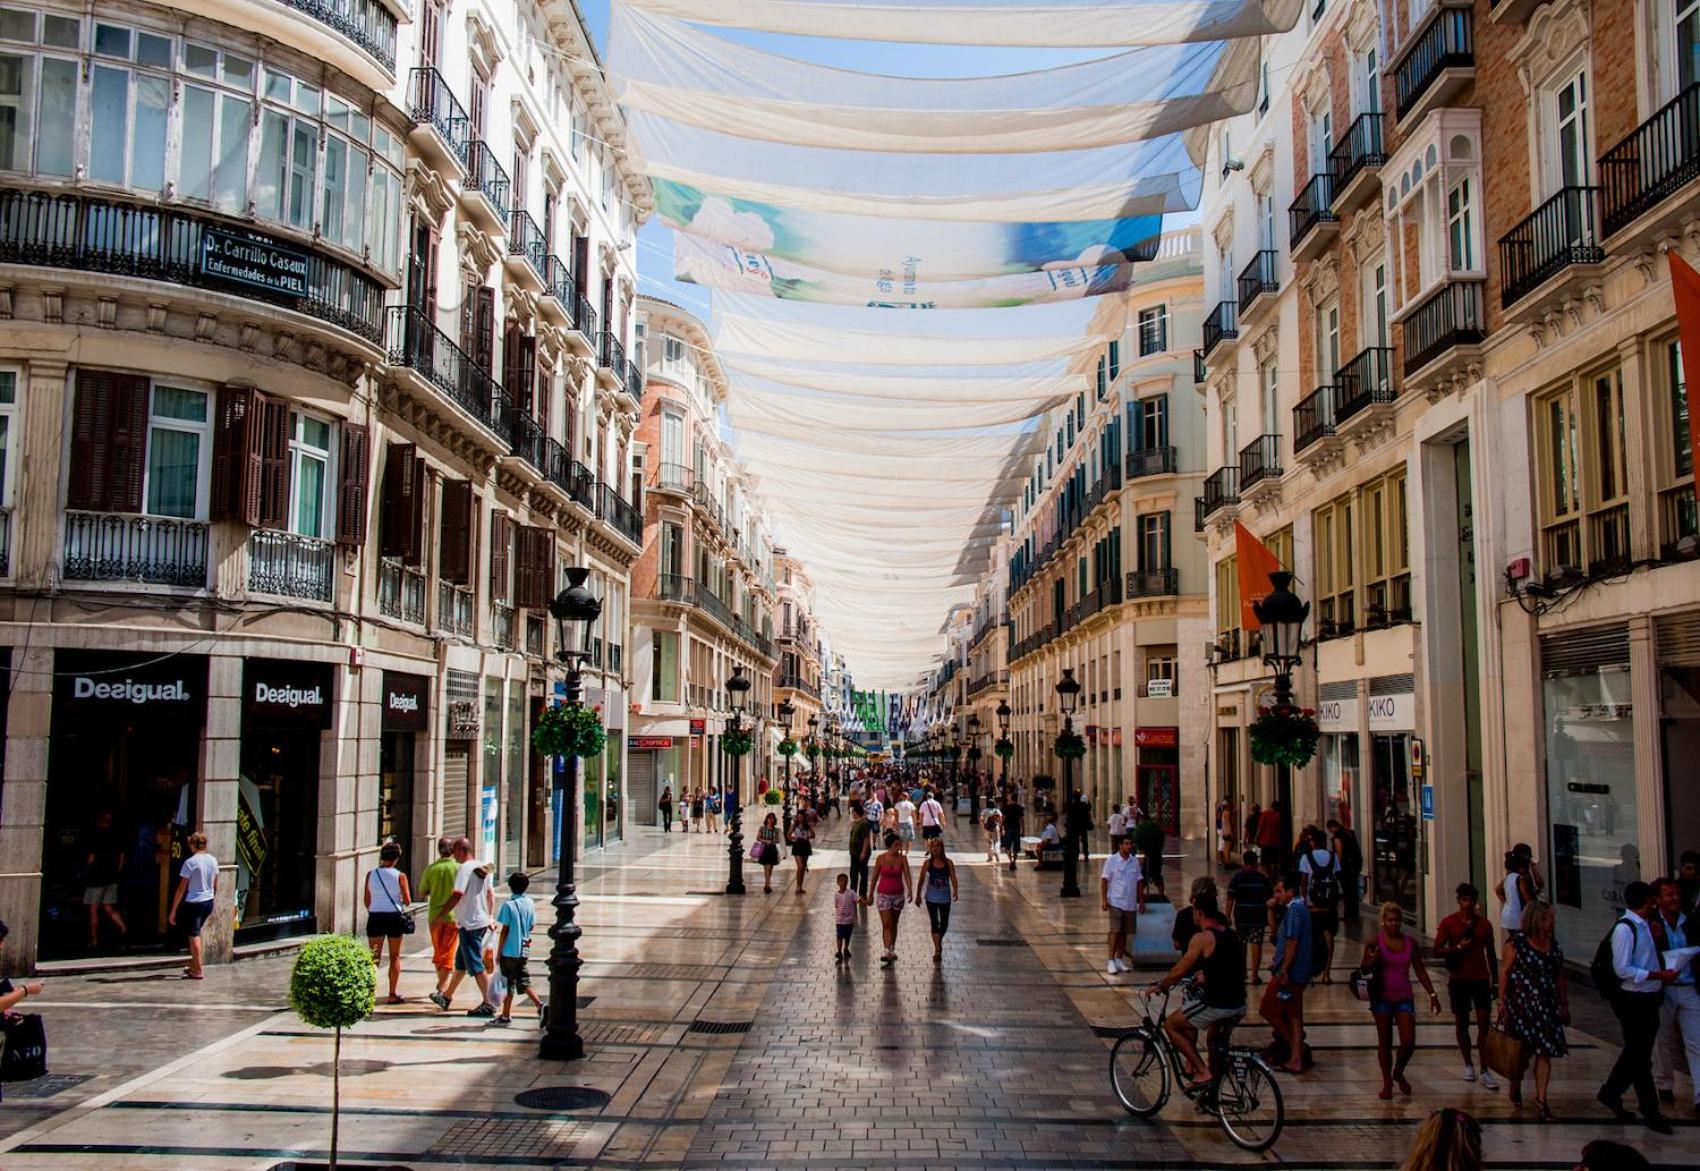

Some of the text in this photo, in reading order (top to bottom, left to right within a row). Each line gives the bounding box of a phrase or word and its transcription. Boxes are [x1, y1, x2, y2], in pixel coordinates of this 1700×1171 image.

[207, 234, 306, 275] Dr. Carrillo Casaux
[208, 257, 266, 283] Enfermedades
[280, 275, 304, 292] PIEL
[1320, 702, 1341, 719] KIKO
[1368, 697, 1395, 717] KIKO
[239, 808, 250, 833] ate
